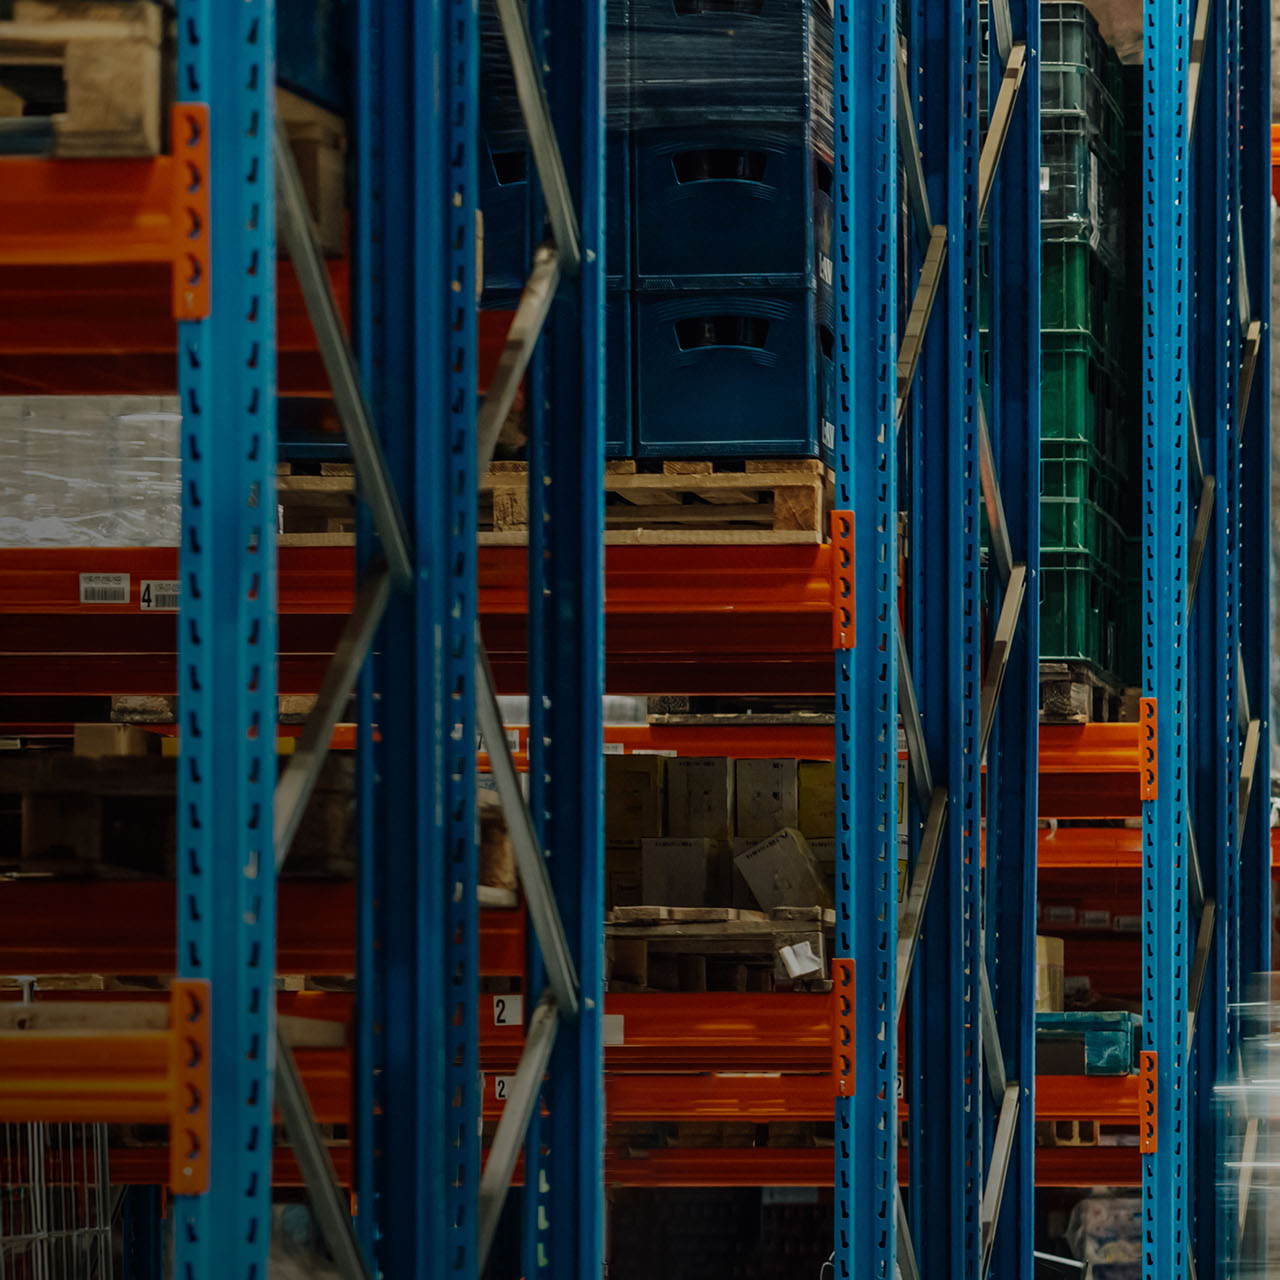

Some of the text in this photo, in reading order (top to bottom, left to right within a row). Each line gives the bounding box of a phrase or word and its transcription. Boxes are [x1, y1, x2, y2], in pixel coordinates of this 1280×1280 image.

[142, 584, 152, 608] 4
[496, 999, 506, 1024] 2
[498, 1080, 506, 1098] 2
